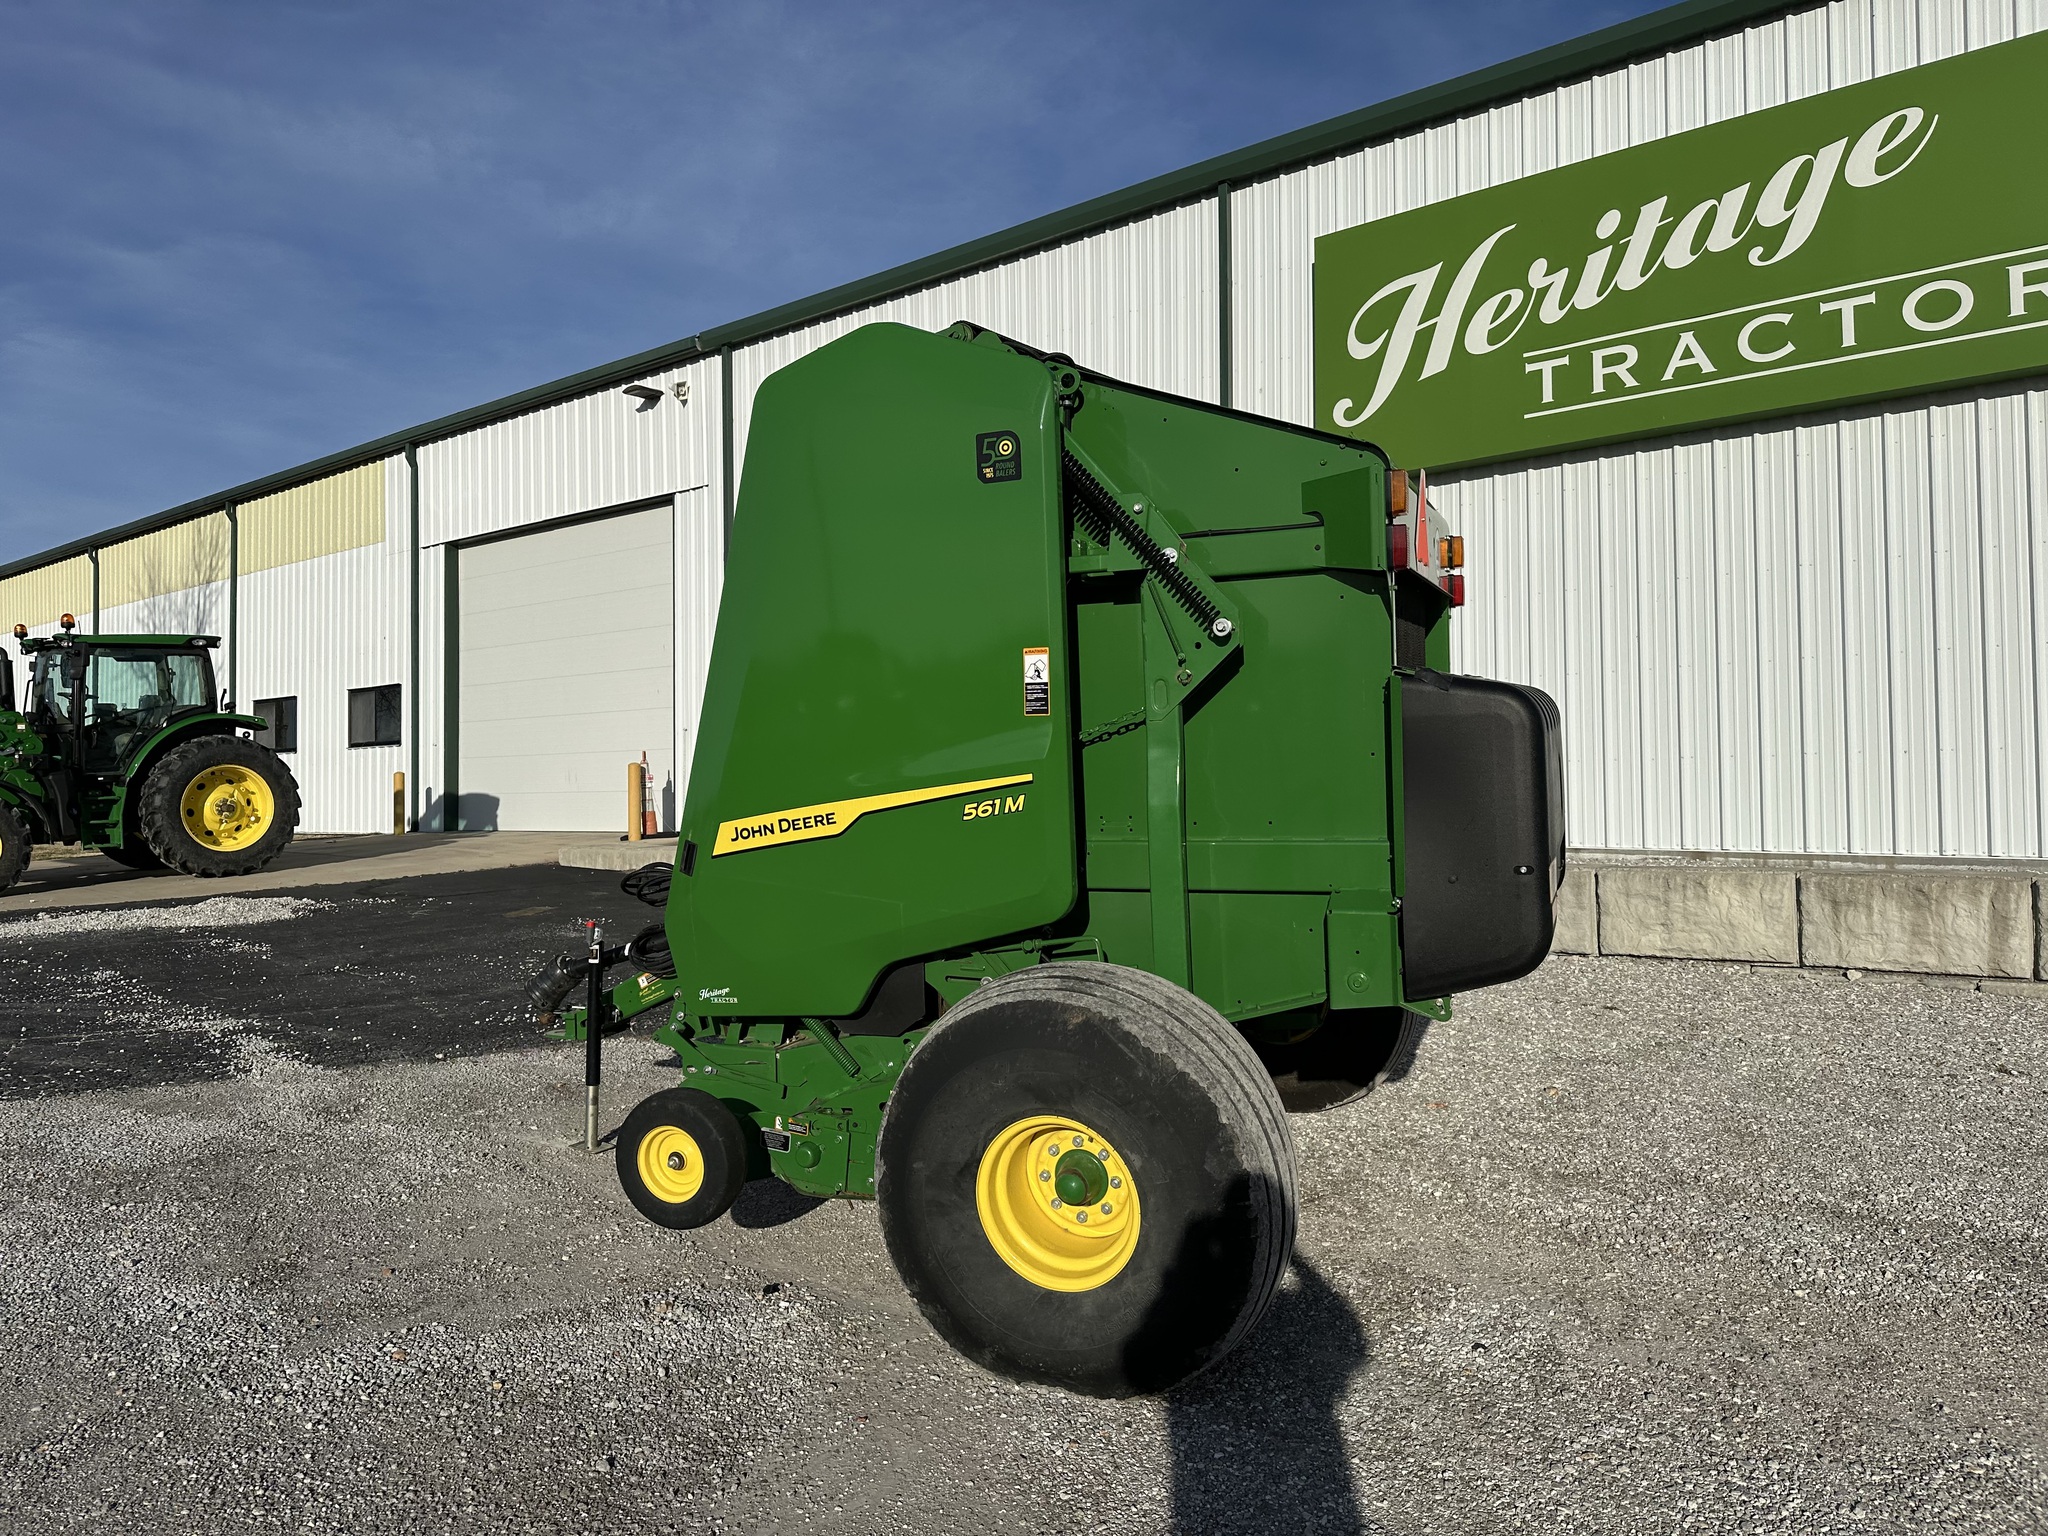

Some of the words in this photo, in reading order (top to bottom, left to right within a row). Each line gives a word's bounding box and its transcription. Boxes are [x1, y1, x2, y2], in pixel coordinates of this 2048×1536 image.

[1333, 106, 1938, 427] Heritage
[981, 436, 1016, 467] 50
[995, 461, 1015, 470] ROUND
[995, 468, 1016, 478] BALERS
[962, 797, 1001, 821] 561
[1003, 794, 1026, 814] M
[731, 823, 775, 842] JOHN
[777, 812, 837, 833] DEERE
[699, 987, 730, 1000] Heritage
